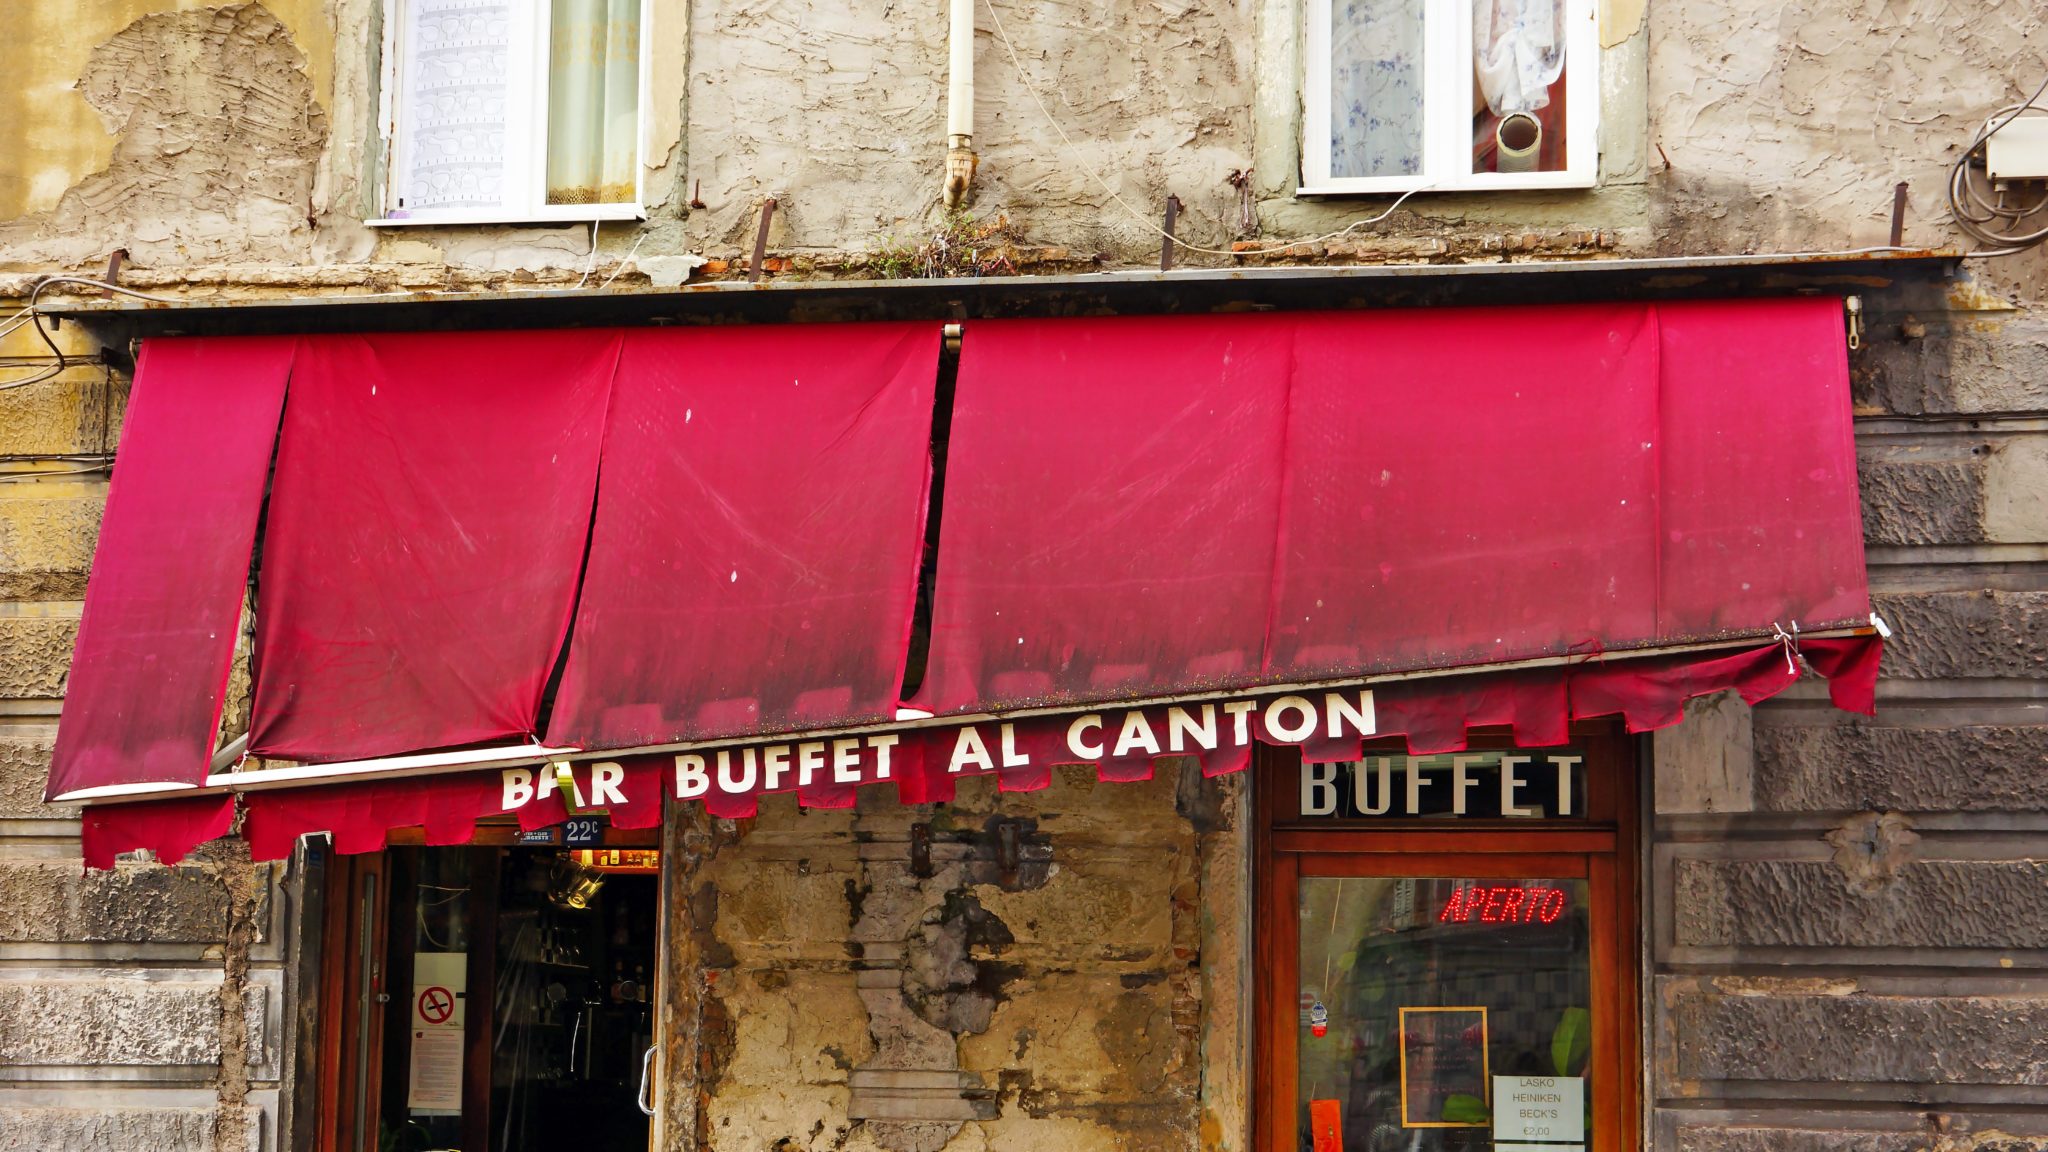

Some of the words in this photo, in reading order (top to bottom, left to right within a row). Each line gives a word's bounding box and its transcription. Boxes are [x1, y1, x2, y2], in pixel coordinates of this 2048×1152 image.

[501, 761, 629, 811] BAR
[675, 733, 899, 799] BUFFET
[948, 723, 1030, 773] AL
[1067, 690, 1376, 760] CANTON
[1301, 755, 1583, 816] BUFFET
[1440, 886, 1566, 923] APERTO
[1520, 1078, 1555, 1088] LASKO
[1512, 1093, 1561, 1103] HEINIKEN
[1519, 1109, 1558, 1119] BECK'S
